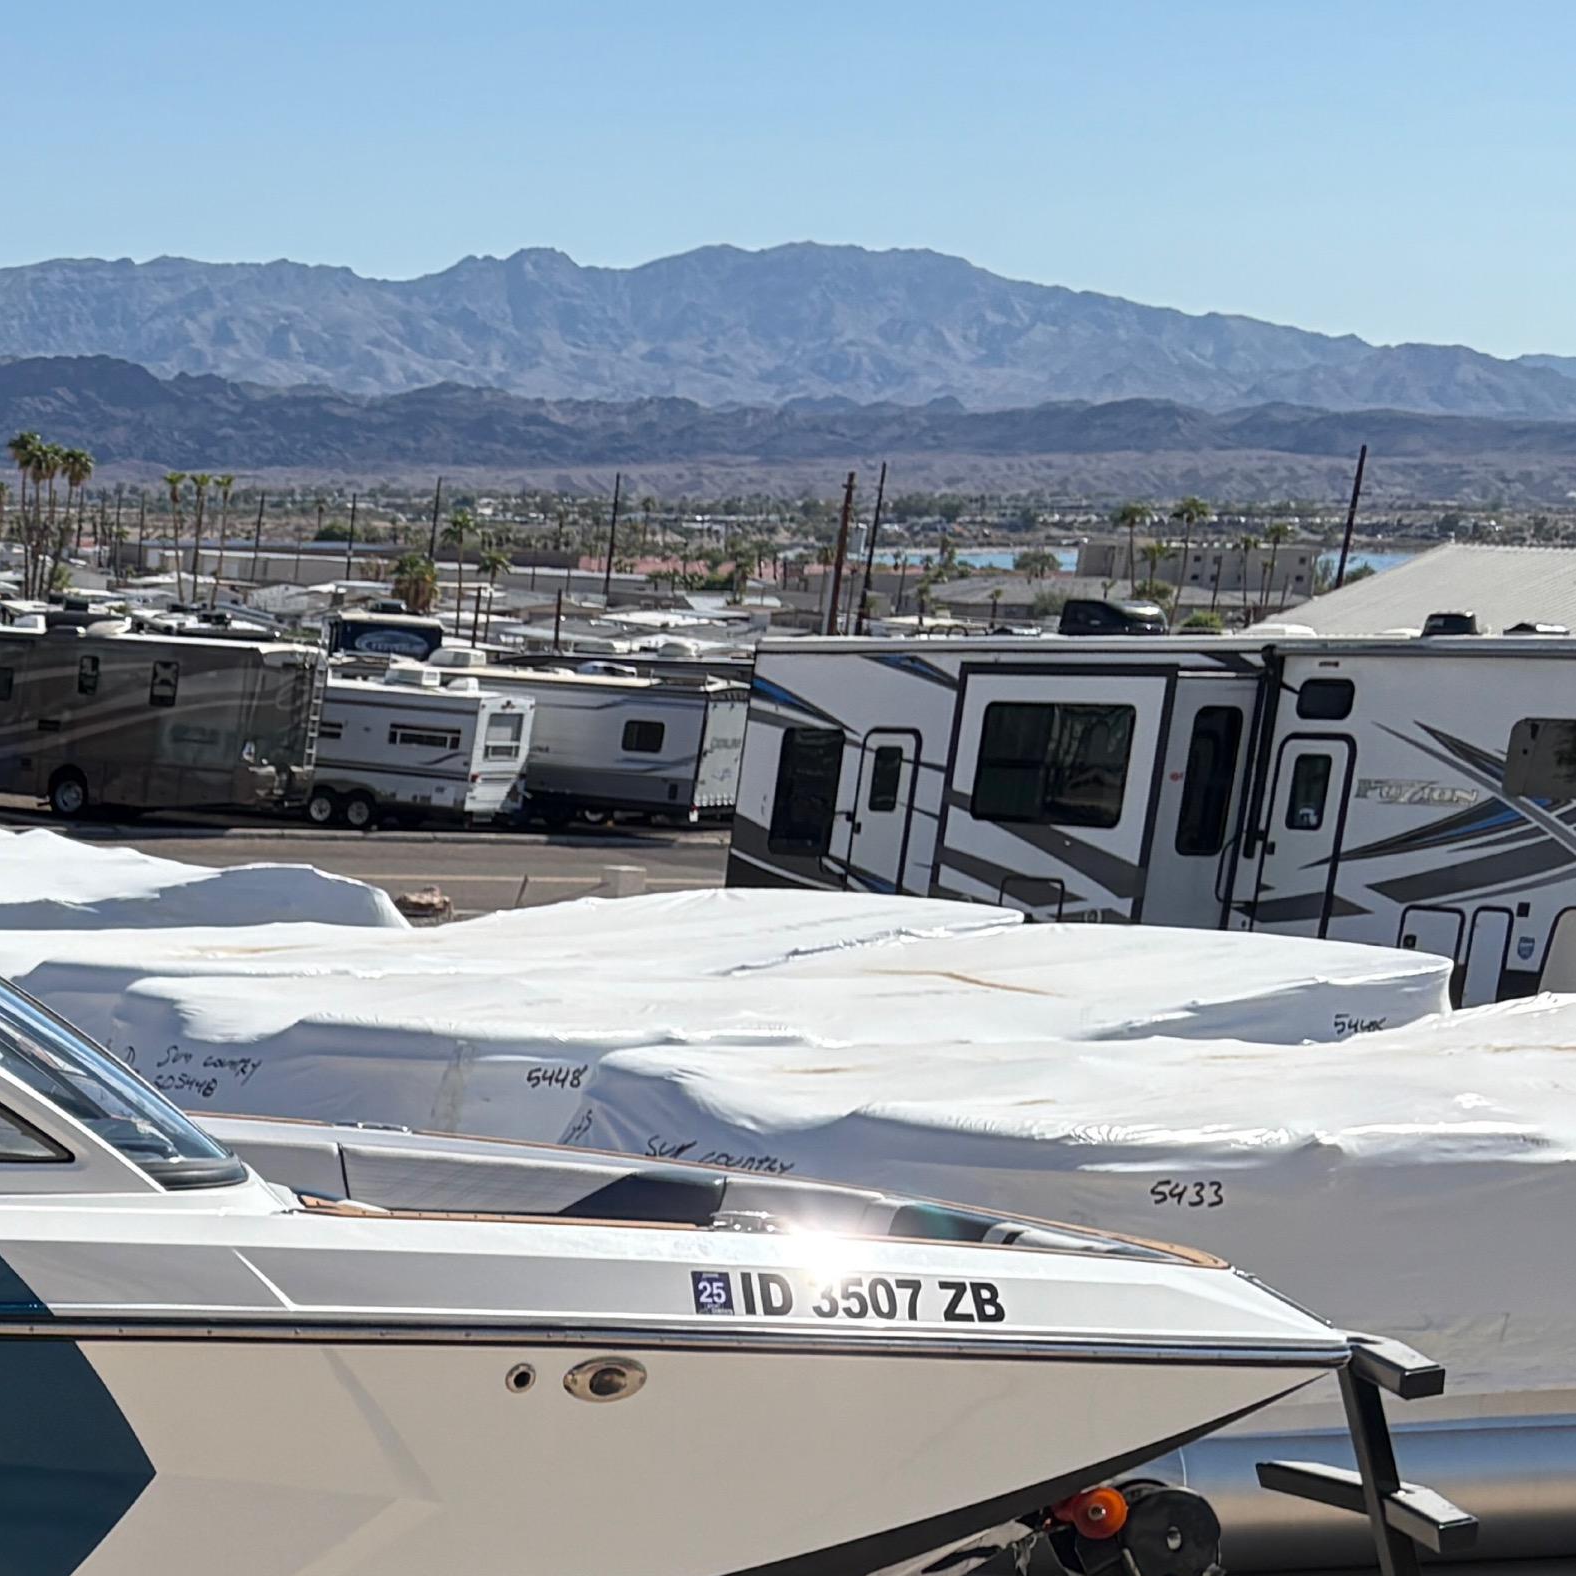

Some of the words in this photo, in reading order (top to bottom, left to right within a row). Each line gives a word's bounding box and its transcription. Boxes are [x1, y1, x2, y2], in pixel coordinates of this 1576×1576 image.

[525, 1064, 589, 1090] 5448
[1149, 1179, 1224, 1208] 5433
[697, 1280, 727, 1304] 25
[740, 1272, 793, 1316] ID
[812, 1278, 922, 1321] 3507
[938, 1281, 1006, 1323] ZB
